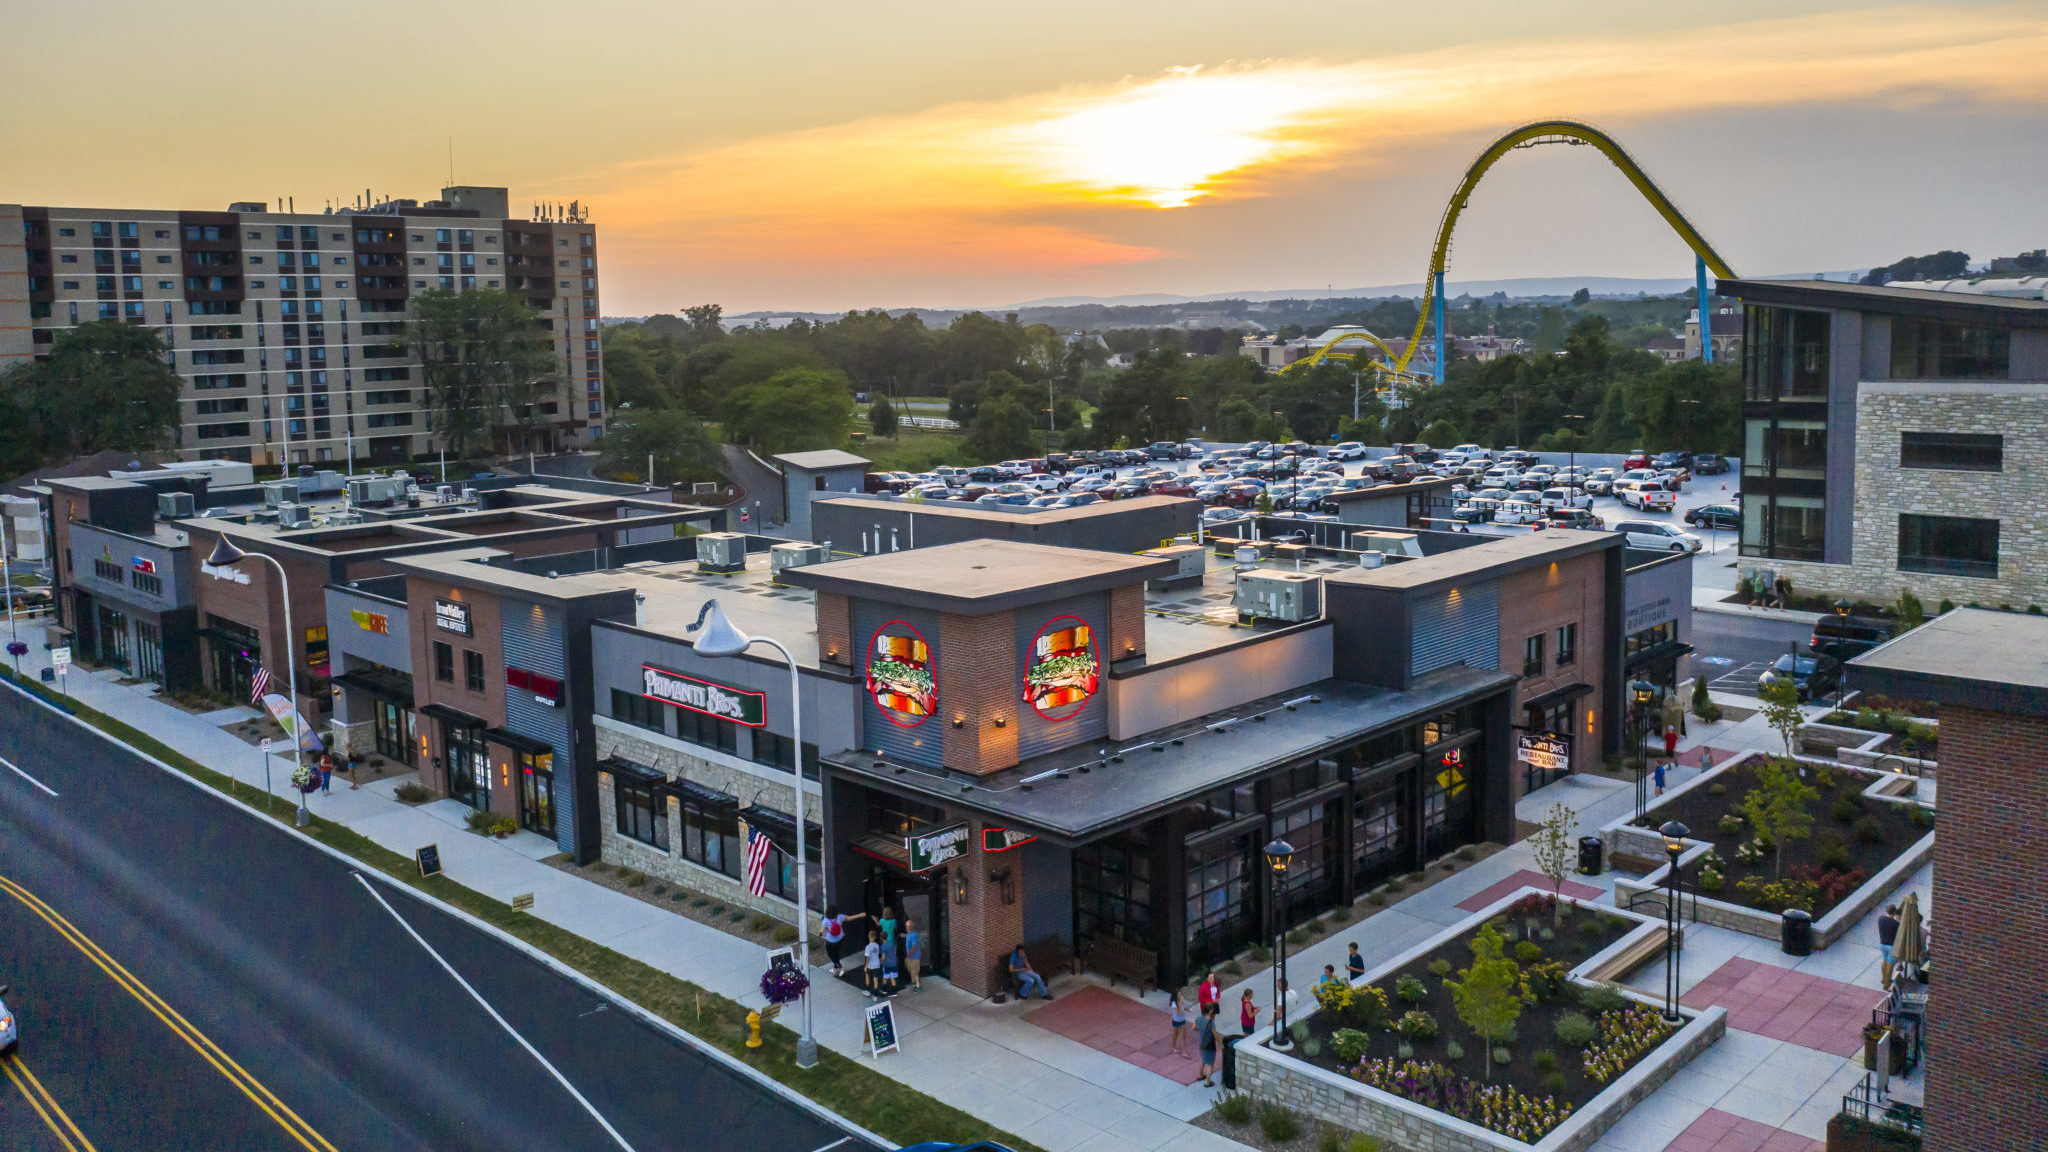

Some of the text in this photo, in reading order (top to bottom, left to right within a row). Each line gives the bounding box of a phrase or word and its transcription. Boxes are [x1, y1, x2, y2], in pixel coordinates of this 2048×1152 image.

[644, 669, 744, 719] PRIMANTI BROS.
[1520, 750, 1565, 763] RESTAURANT
[1542, 759, 1557, 767] BAR
[917, 827, 969, 856] PRIMANTI
